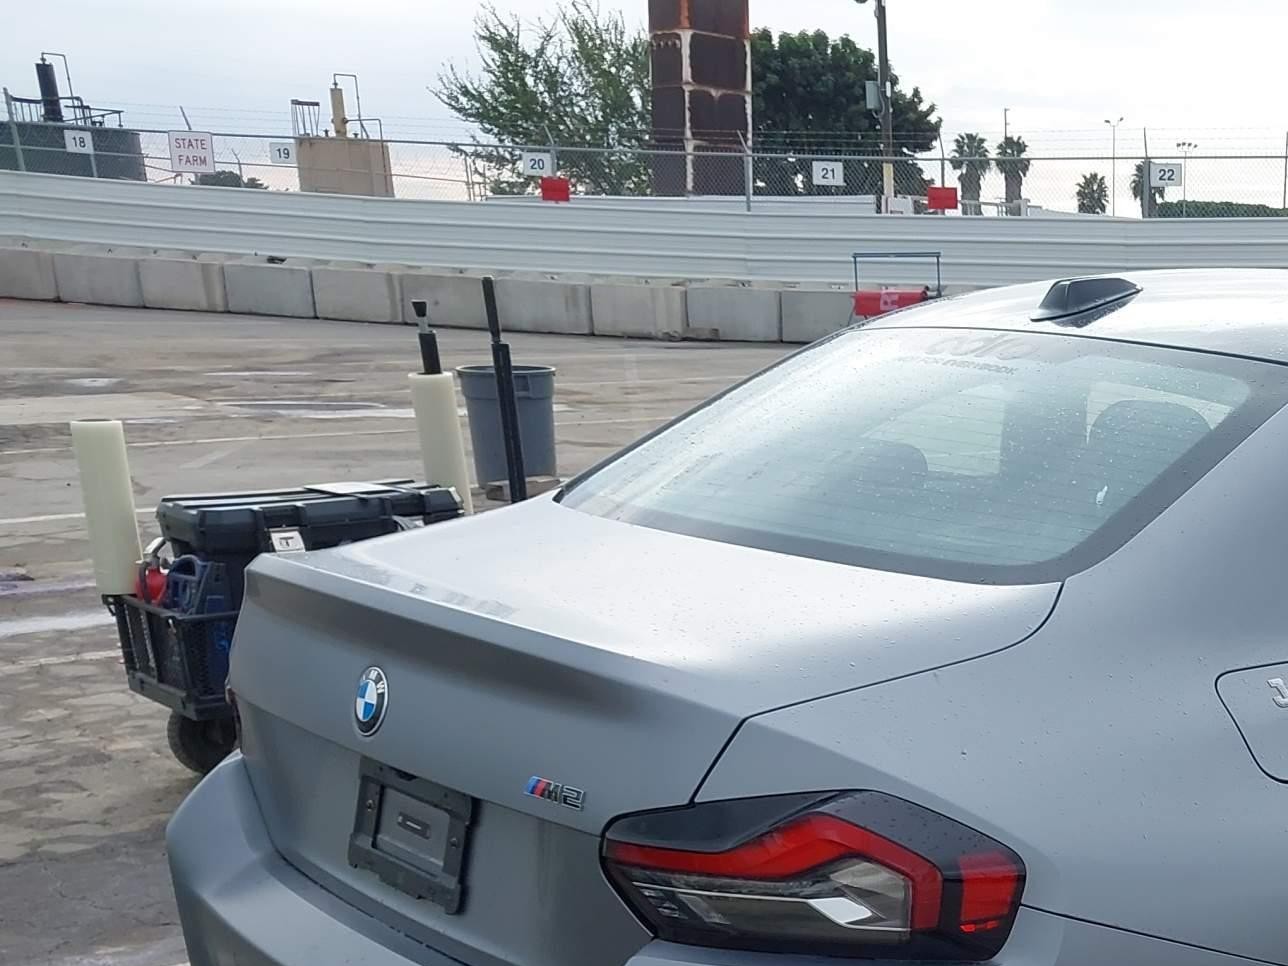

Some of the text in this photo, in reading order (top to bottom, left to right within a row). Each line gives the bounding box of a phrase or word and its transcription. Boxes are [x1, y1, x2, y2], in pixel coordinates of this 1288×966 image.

[72, 136, 86, 149] 18
[174, 137, 207, 150] STATE
[276, 147, 290, 160] 19
[178, 154, 207, 167] FARM
[529, 158, 545, 171] 20
[821, 167, 836, 180] 21
[1158, 168, 1175, 182] 22
